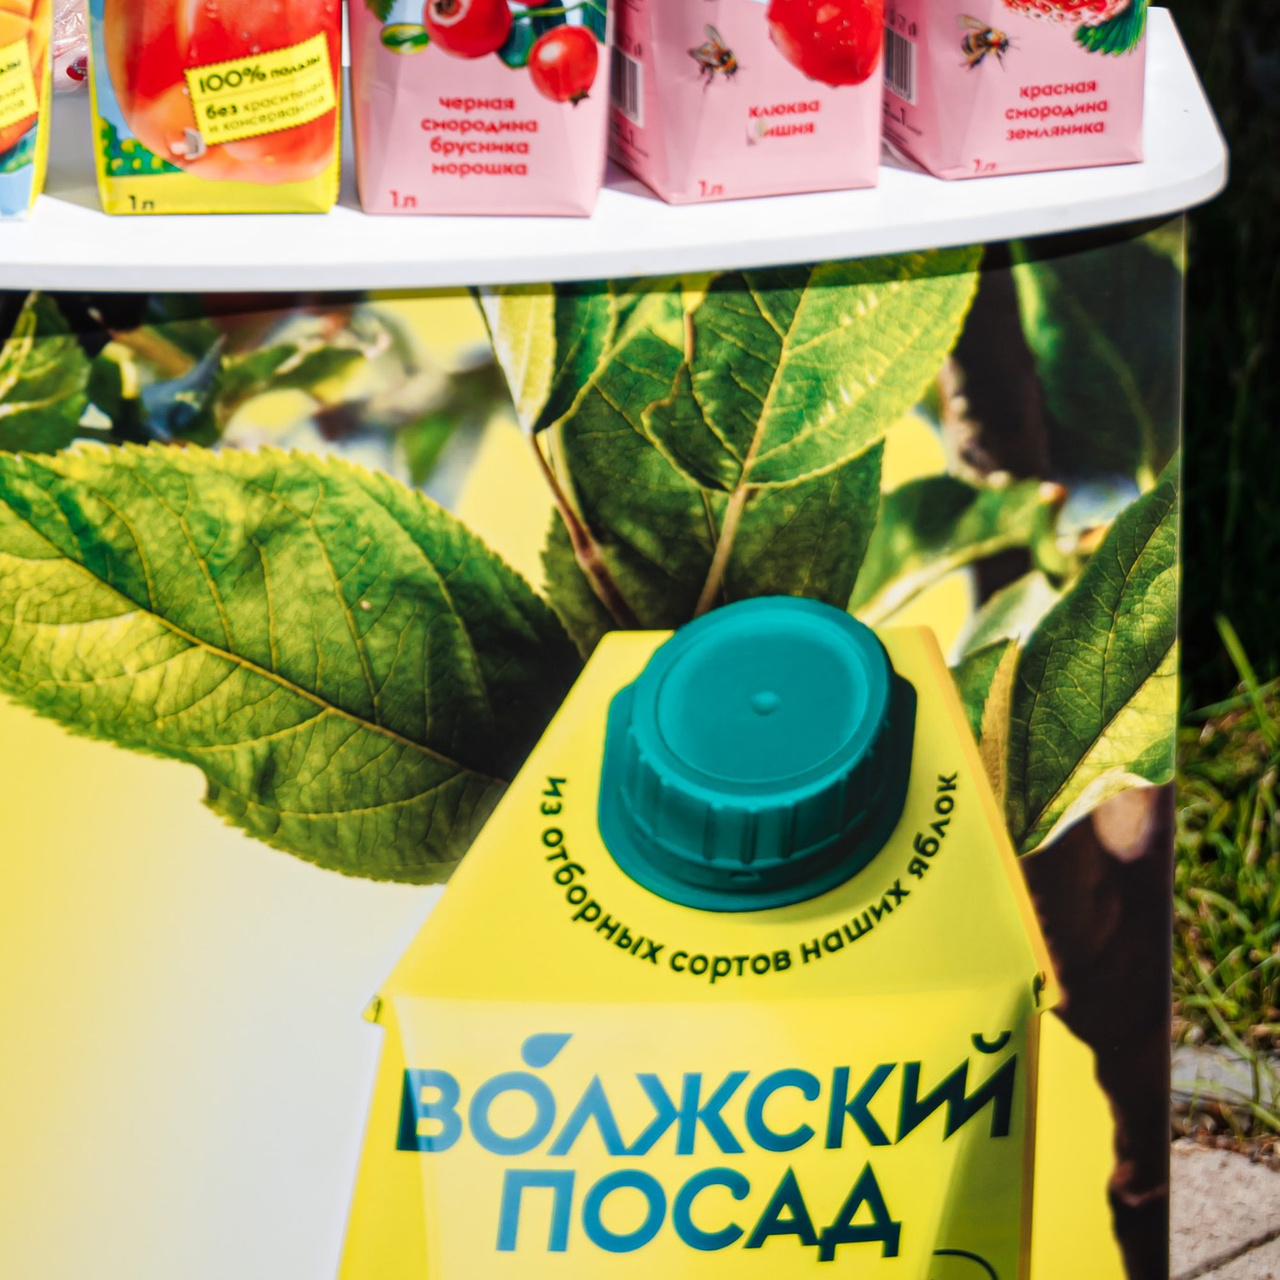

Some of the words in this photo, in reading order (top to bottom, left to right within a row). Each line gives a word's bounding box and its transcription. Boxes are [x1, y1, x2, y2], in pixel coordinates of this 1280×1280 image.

[199, 65, 266, 93] 100%
[1020, 80, 1097, 101] красная
[206, 104, 237, 119] без
[439, 96, 515, 113] черная
[749, 100, 820, 118] клюква
[1005, 99, 1108, 121] смородина
[421, 118, 538, 135] смородина
[763, 122, 816, 138] ишня
[1006, 121, 1105, 140] земляника
[430, 136, 530, 156] брусника
[432, 163, 528, 178] морошка
[540, 776, 567, 816] из
[906, 772, 960, 879] яблок
[540, 826, 666, 966] отборных
[800, 880, 911, 965] наших
[669, 948, 793, 984] сортов
[396, 1030, 1018, 1156] ВОЛЖСКИЙ
[496, 1161, 902, 1262] ПОСАД
